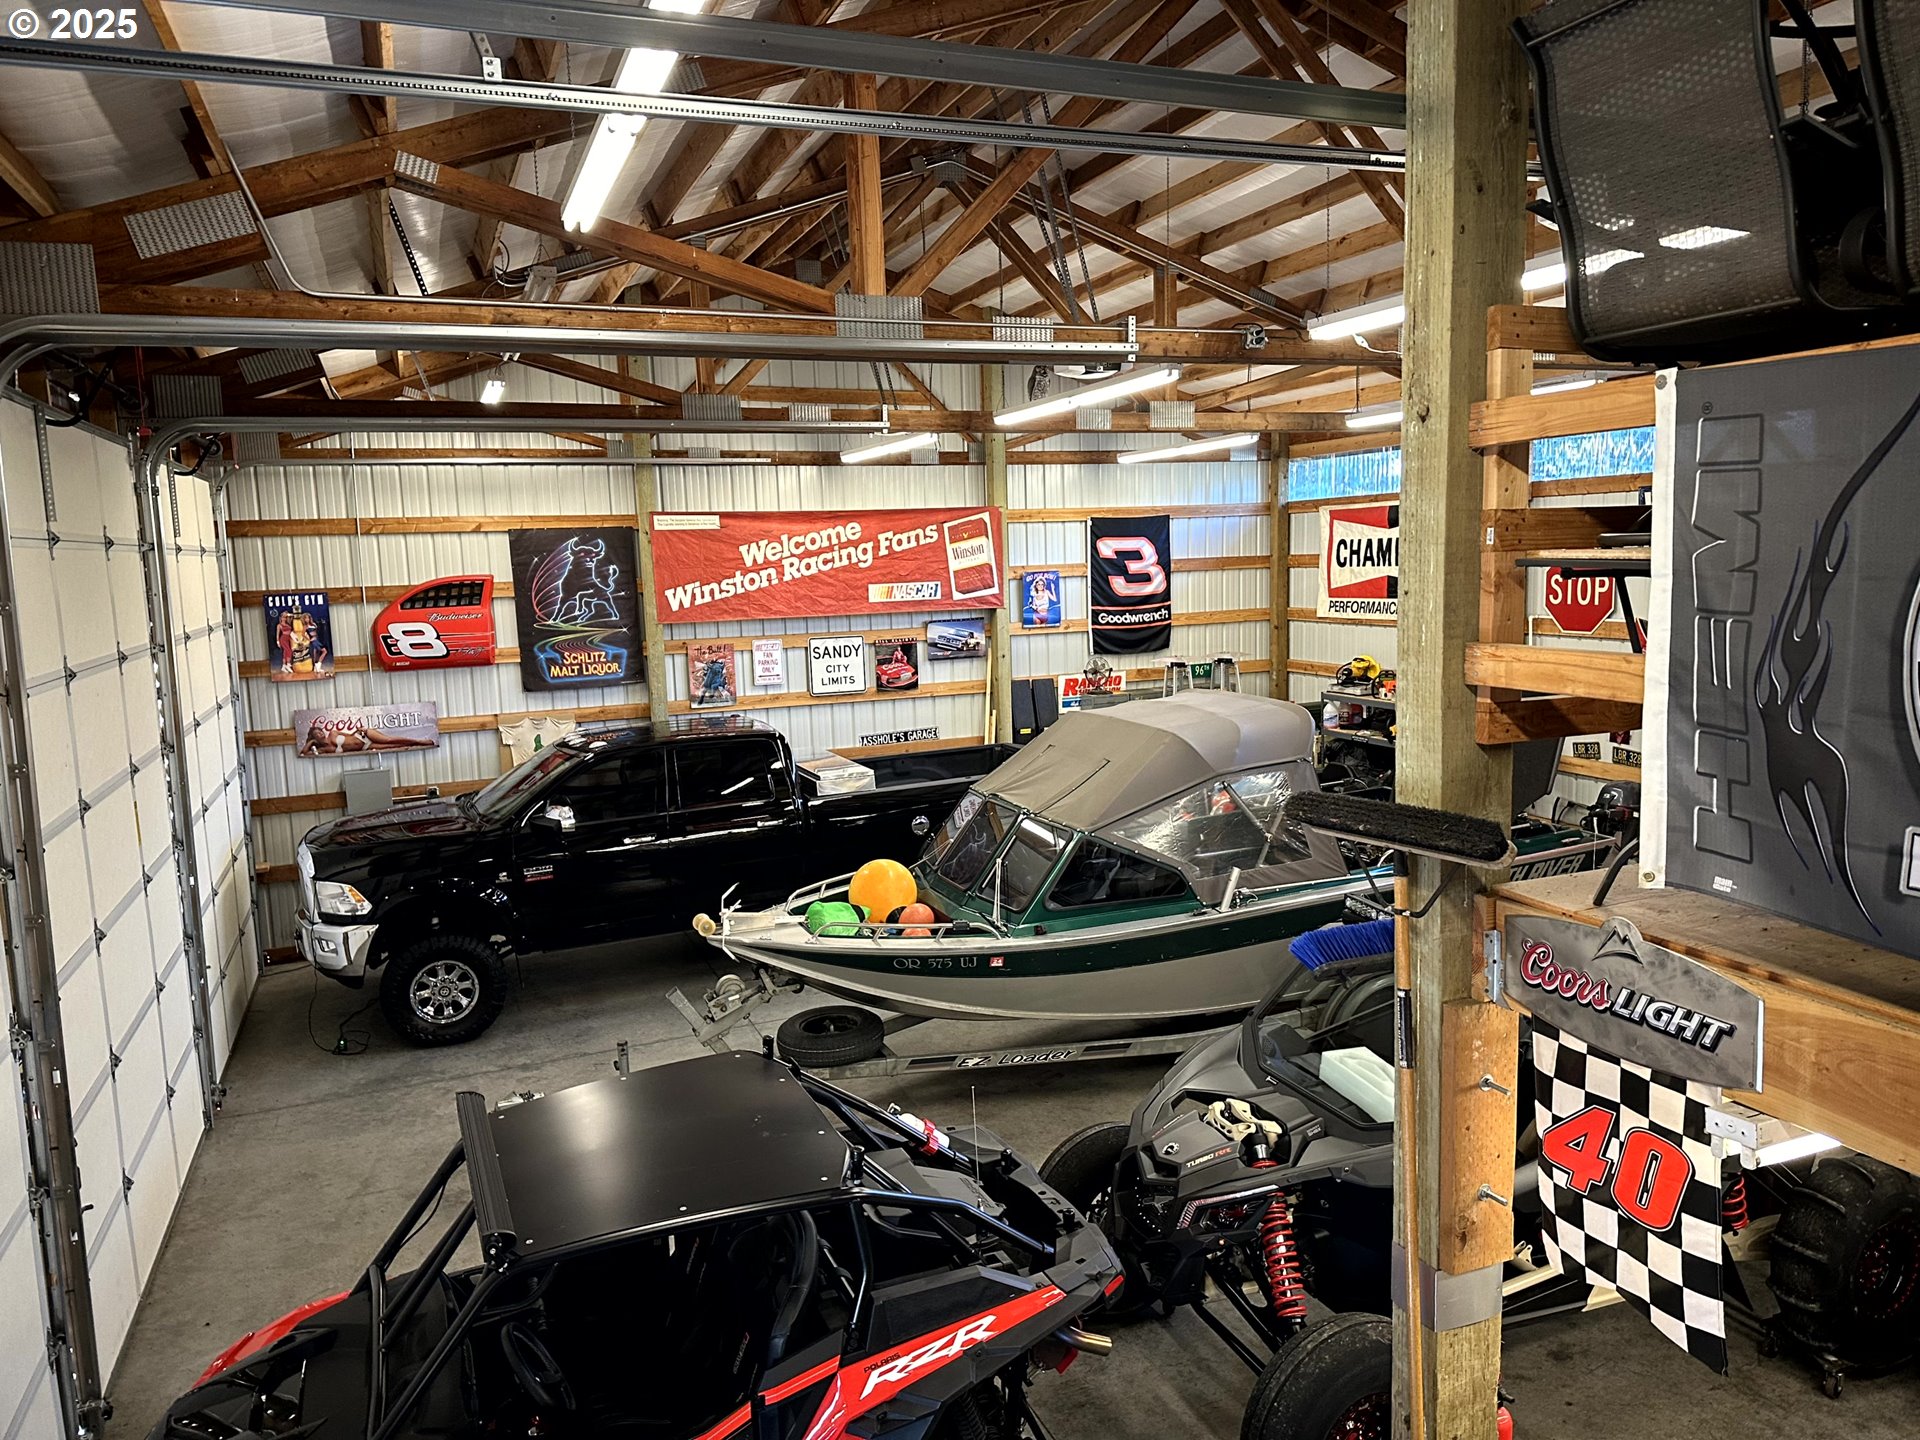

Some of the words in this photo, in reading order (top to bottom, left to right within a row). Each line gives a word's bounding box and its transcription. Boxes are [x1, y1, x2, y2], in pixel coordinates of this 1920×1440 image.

[739, 521, 862, 567] Welcome
[952, 543, 985, 561] Winston
[664, 566, 779, 612] Winston
[782, 541, 874, 585] Racing
[877, 523, 939, 557] Fans
[1096, 536, 1167, 597] 3
[893, 582, 940, 599] NASCAR
[1548, 574, 1610, 606] STOP
[268, 595, 300, 607] GOLD'S
[304, 594, 324, 606] GYM
[1328, 600, 1398, 615] PERFORMANC
[428, 613, 483, 622] Budweiser
[1098, 608, 1169, 624] Goodwrench
[387, 621, 450, 659] 8
[563, 652, 607, 664] SCHLITZ
[694, 646, 707, 656] The
[812, 644, 861, 660] SANDY
[550, 665, 580, 678] MALT
[582, 663, 622, 676] LIQUOR
[825, 663, 850, 674] CITY
[821, 676, 856, 686] LIMITS
[310, 715, 364, 732] Coors
[366, 711, 421, 730] LIGHT
[863, 732, 905, 746] ASSHOLE'S
[907, 728, 936, 741] GARAGE
[1527, 854, 1586, 881] RIVER
[893, 957, 921, 969] OR
[927, 958, 953, 969] 575
[960, 957, 978, 968] UJ
[1521, 938, 1612, 1011] Coors
[1610, 986, 1738, 1053] LIGHT
[957, 1055, 992, 1068] EZ
[997, 1049, 1077, 1066] Loader
[1186, 1153, 1215, 1168] TURBO
[1542, 1104, 1695, 1234] 40
[859, 1314, 999, 1401] RZR
[863, 1352, 902, 1374] POLARIS
